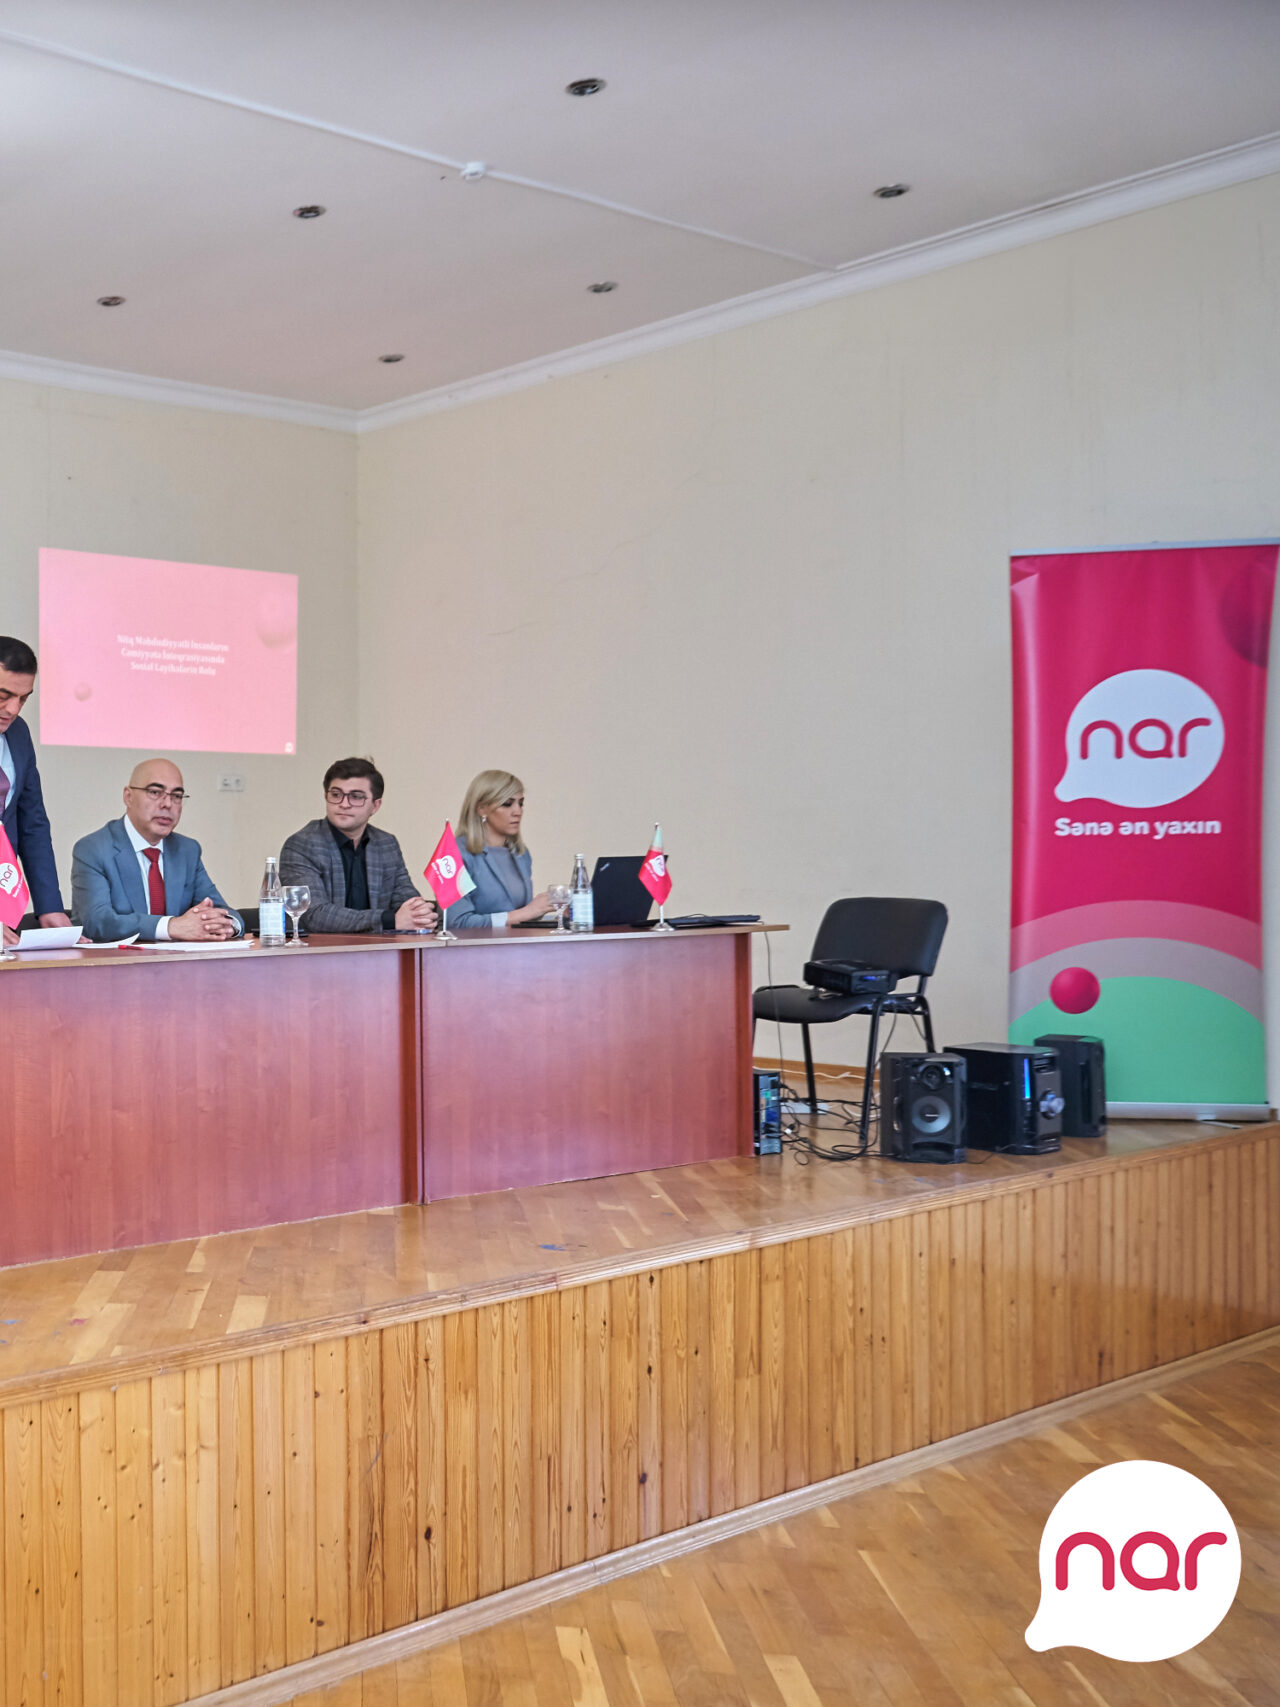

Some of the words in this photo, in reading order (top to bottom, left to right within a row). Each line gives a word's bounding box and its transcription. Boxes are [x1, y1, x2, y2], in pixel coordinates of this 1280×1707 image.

[1080, 717, 1212, 760] nar
[1054, 817, 1114, 836] Sənə
[1118, 821, 1150, 835] ən
[1153, 820, 1222, 840] yaxın
[0, 864, 14, 887] nar
